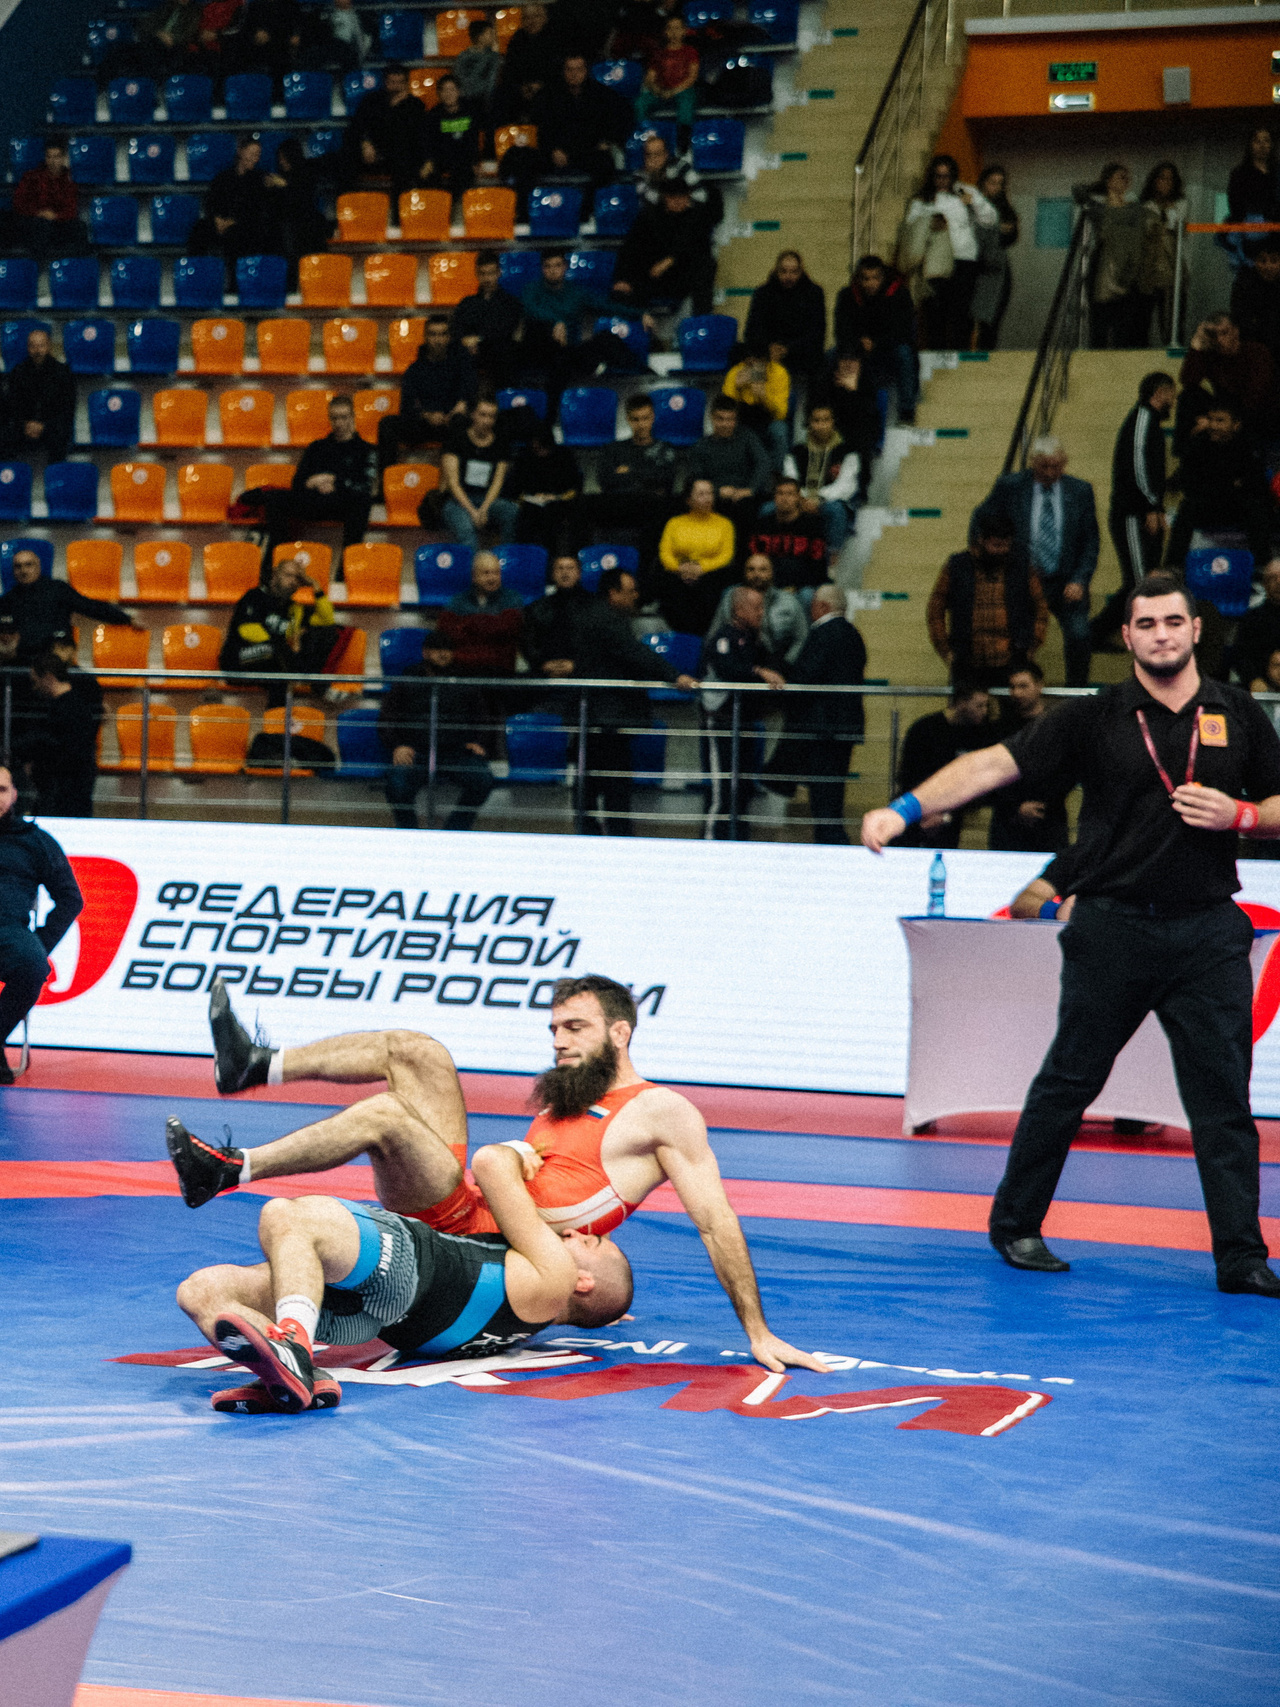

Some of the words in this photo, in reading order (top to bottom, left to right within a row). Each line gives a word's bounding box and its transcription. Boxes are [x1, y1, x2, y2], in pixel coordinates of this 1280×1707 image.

[156, 881, 556, 929] ФЕДЕРАЦИЯ
[139, 920, 581, 969] СПОРТИВНОЙ
[121, 960, 382, 1002] БОРЬБЫ
[393, 972, 666, 1017] РОССИ
